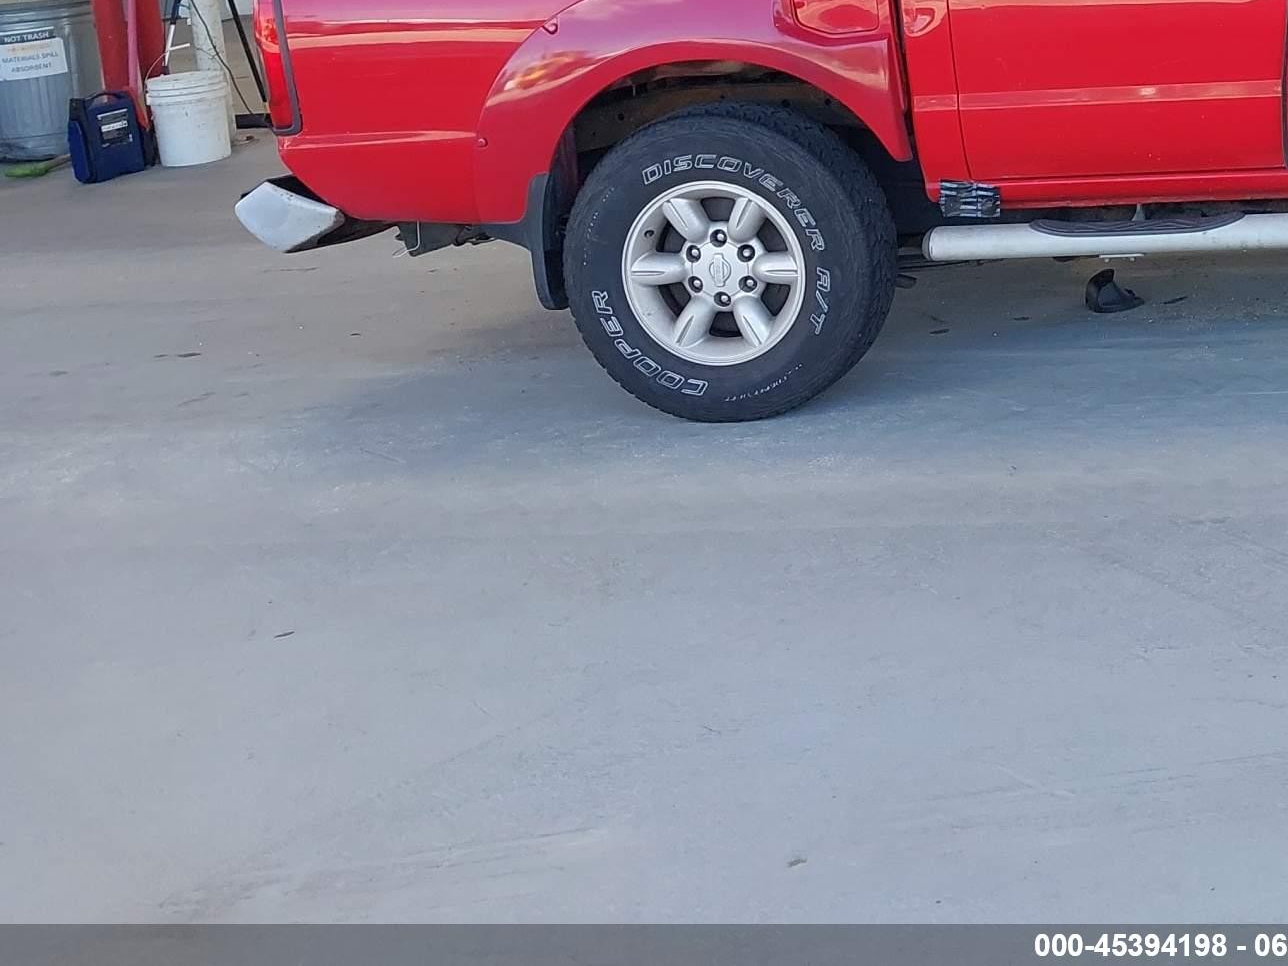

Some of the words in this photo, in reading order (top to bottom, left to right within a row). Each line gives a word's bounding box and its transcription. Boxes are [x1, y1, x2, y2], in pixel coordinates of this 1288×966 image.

[4, 35, 21, 43] NOT
[23, 31, 49, 41] TRASH
[641, 154, 825, 251] DISCOVERER
[809, 266, 831, 334] A/T
[592, 290, 709, 396] COOPER
